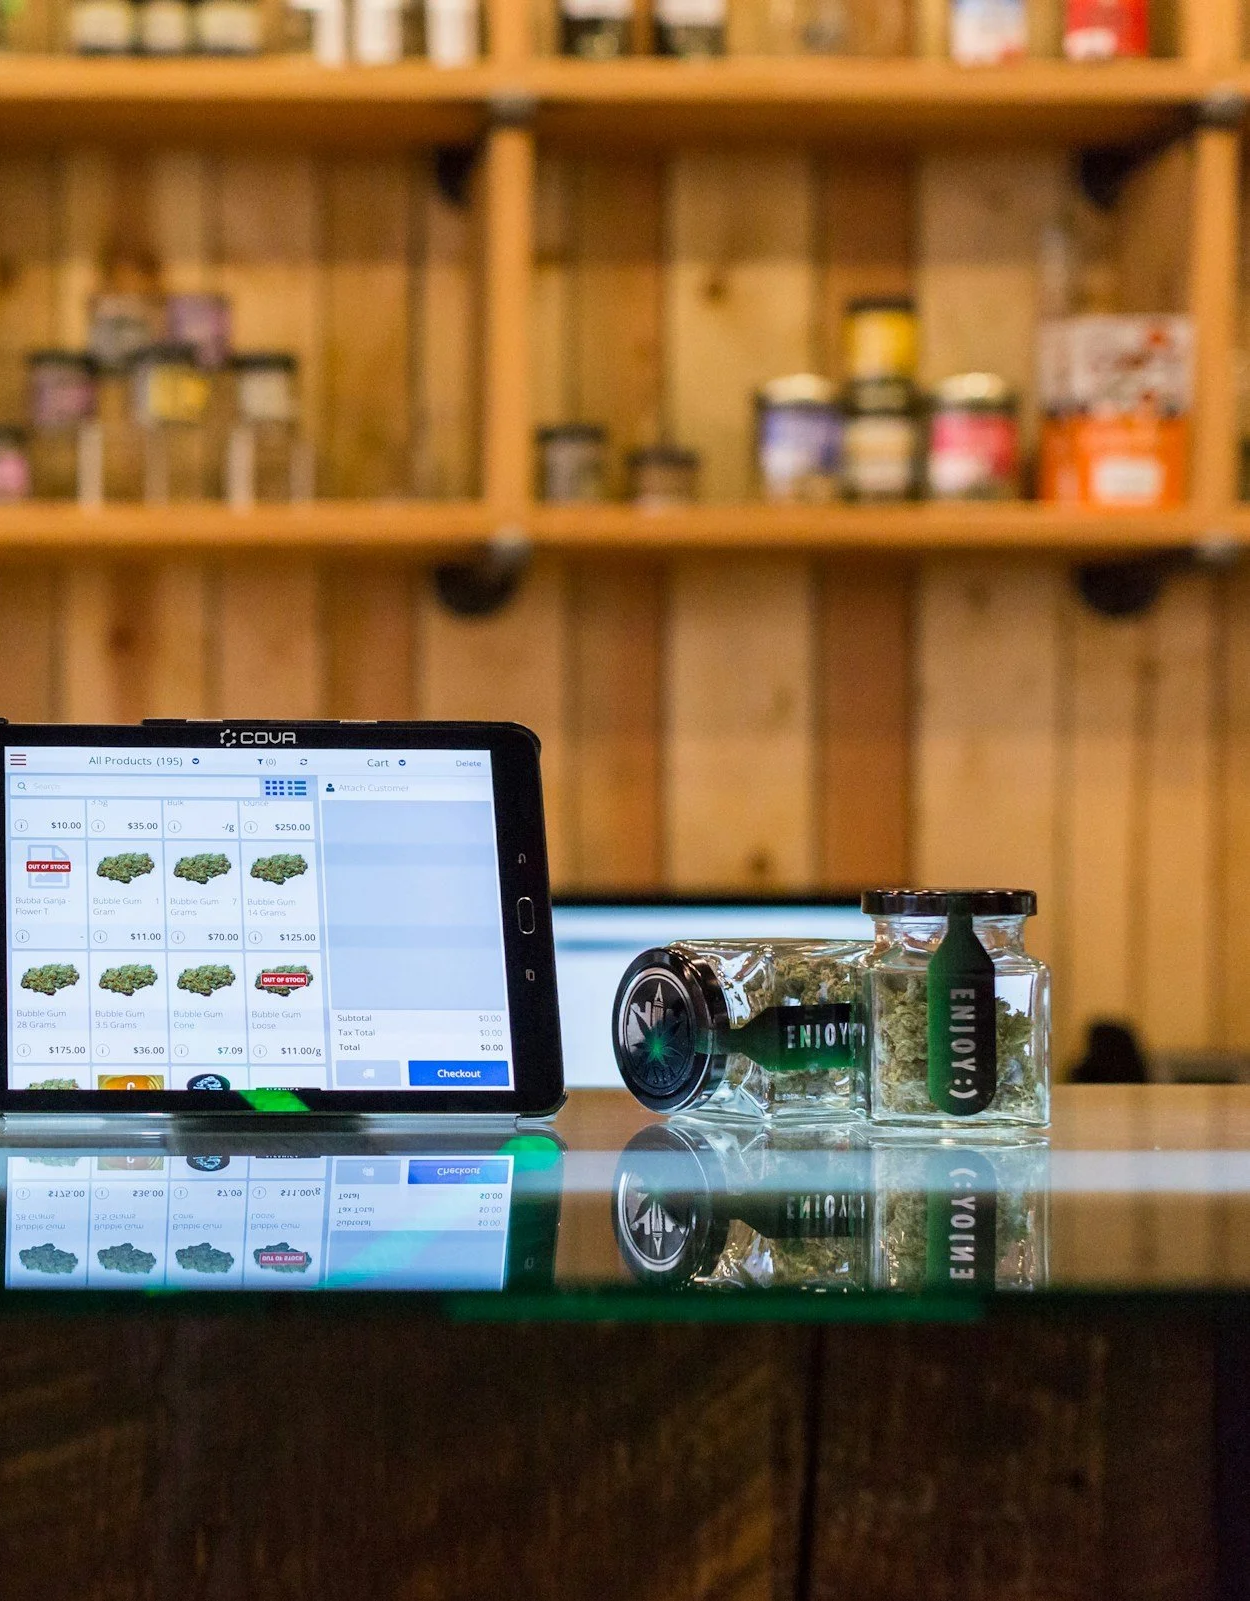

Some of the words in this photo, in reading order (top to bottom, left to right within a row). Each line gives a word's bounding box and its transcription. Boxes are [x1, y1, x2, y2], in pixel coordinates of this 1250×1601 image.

[240, 732, 296, 744] COVA
[89, 756, 101, 765] All
[105, 756, 152, 766] Products
[156, 757, 183, 767] (195)
[265, 758, 277, 767] (0)
[367, 758, 390, 768] Cart
[455, 760, 482, 768] Delete
[33, 782, 61, 791] Search
[338, 784, 366, 792] Attach
[368, 784, 409, 792] Customer
[51, 821, 82, 830] $10.00
[127, 822, 158, 830] $35.00
[275, 823, 311, 831] $250.00
[15, 896, 41, 904] Bubba
[43, 897, 66, 906] Ganja
[93, 897, 121, 905] Bubble
[170, 897, 198, 905] Bubble
[247, 897, 275, 906] Bubble
[93, 908, 116, 916] Gram
[259, 909, 286, 917] Grams
[130, 932, 161, 941] $11.00
[208, 933, 239, 941] $70.00
[279, 933, 316, 942] $125.00
[16, 1009, 45, 1018] Bubble
[46, 1010, 67, 1018] Gum
[95, 1010, 124, 1018] Bubble
[125, 1010, 145, 1018] Gum
[173, 1010, 202, 1018] Bubble
[251, 1010, 280, 1018] Bubble
[337, 1014, 372, 1022] Subtotal
[478, 1014, 502, 1023] $0.00
[16, 1021, 28, 1029] 28
[29, 1021, 57, 1029] Grams
[95, 1021, 108, 1029] 3.5
[110, 1021, 138, 1029] Grams
[173, 1021, 195, 1029] Cone
[252, 1022, 276, 1030] Loose
[479, 1029, 503, 1037] $0.00
[949, 989, 976, 1072] ENJOY
[48, 1046, 86, 1054] $175.00
[133, 1046, 165, 1055] $36.00
[217, 1046, 243, 1055] $7.09
[339, 1043, 361, 1051] Total
[480, 1044, 504, 1052] $0.00
[281, 1047, 322, 1057] $11.00/g
[437, 1069, 481, 1079] Checkout
